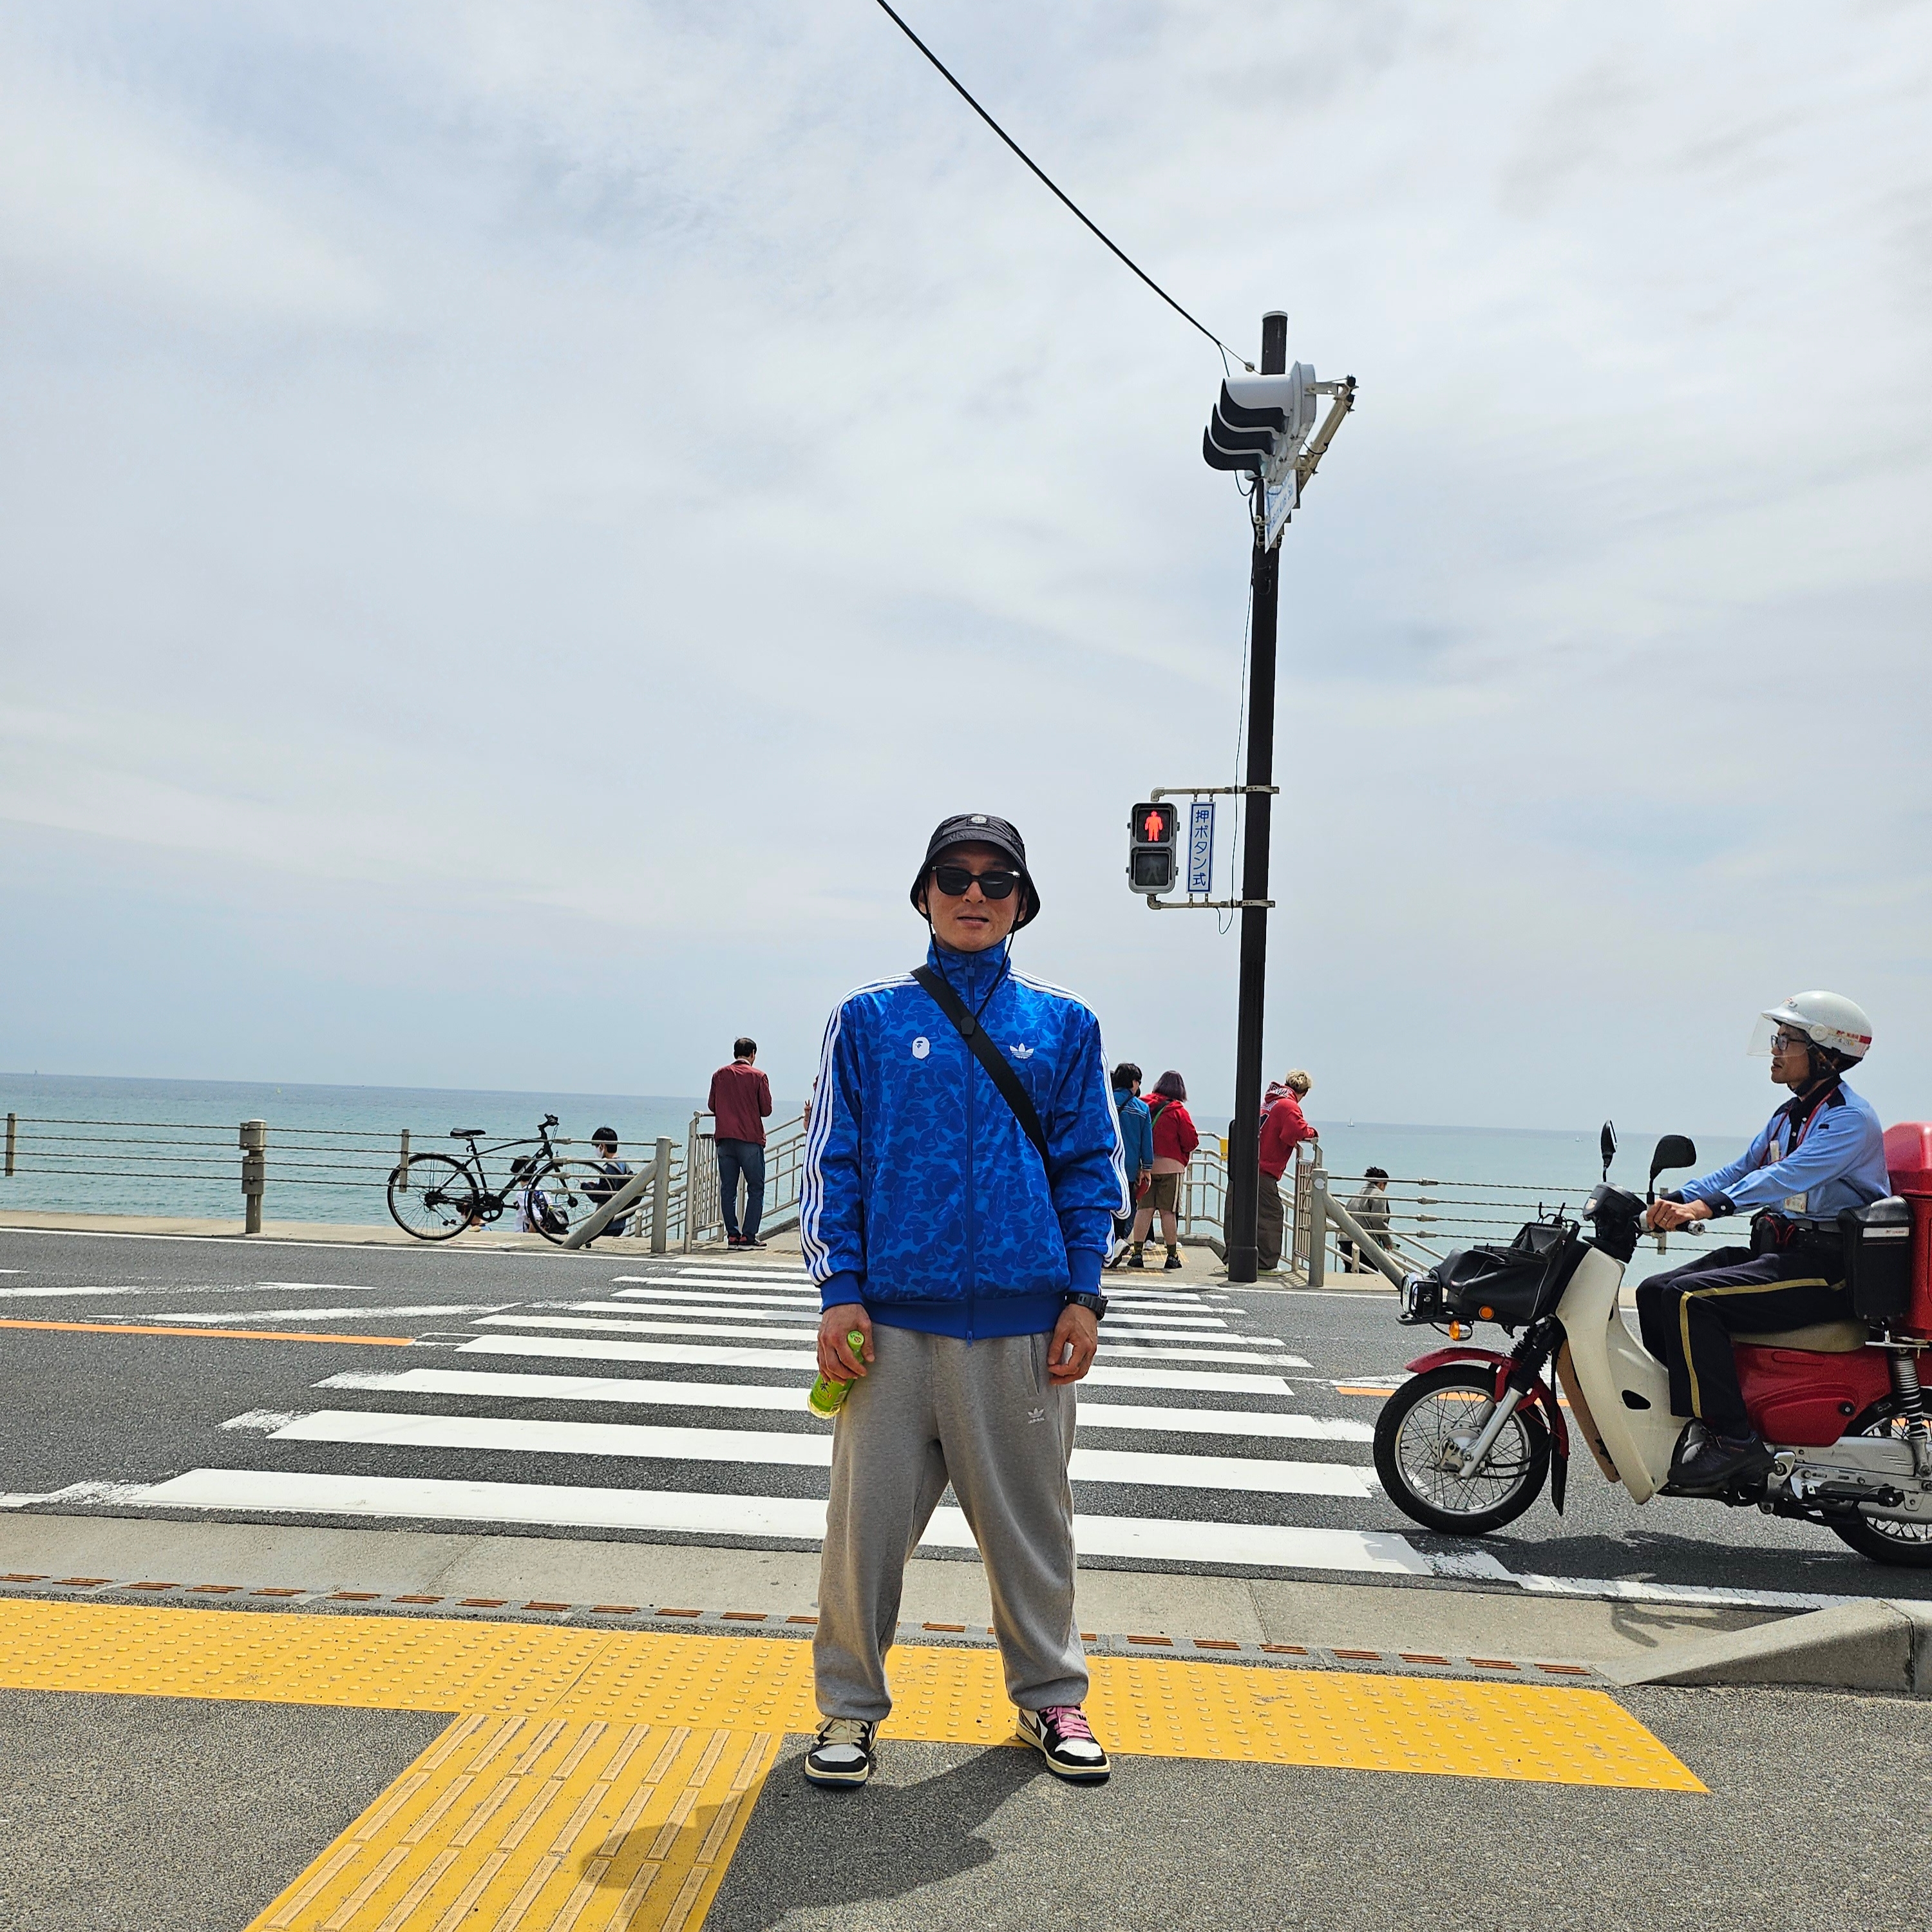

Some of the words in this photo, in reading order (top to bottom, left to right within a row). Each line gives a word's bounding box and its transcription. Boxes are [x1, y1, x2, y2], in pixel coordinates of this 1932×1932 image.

[1192, 810, 1209, 887] 押ボタン式
